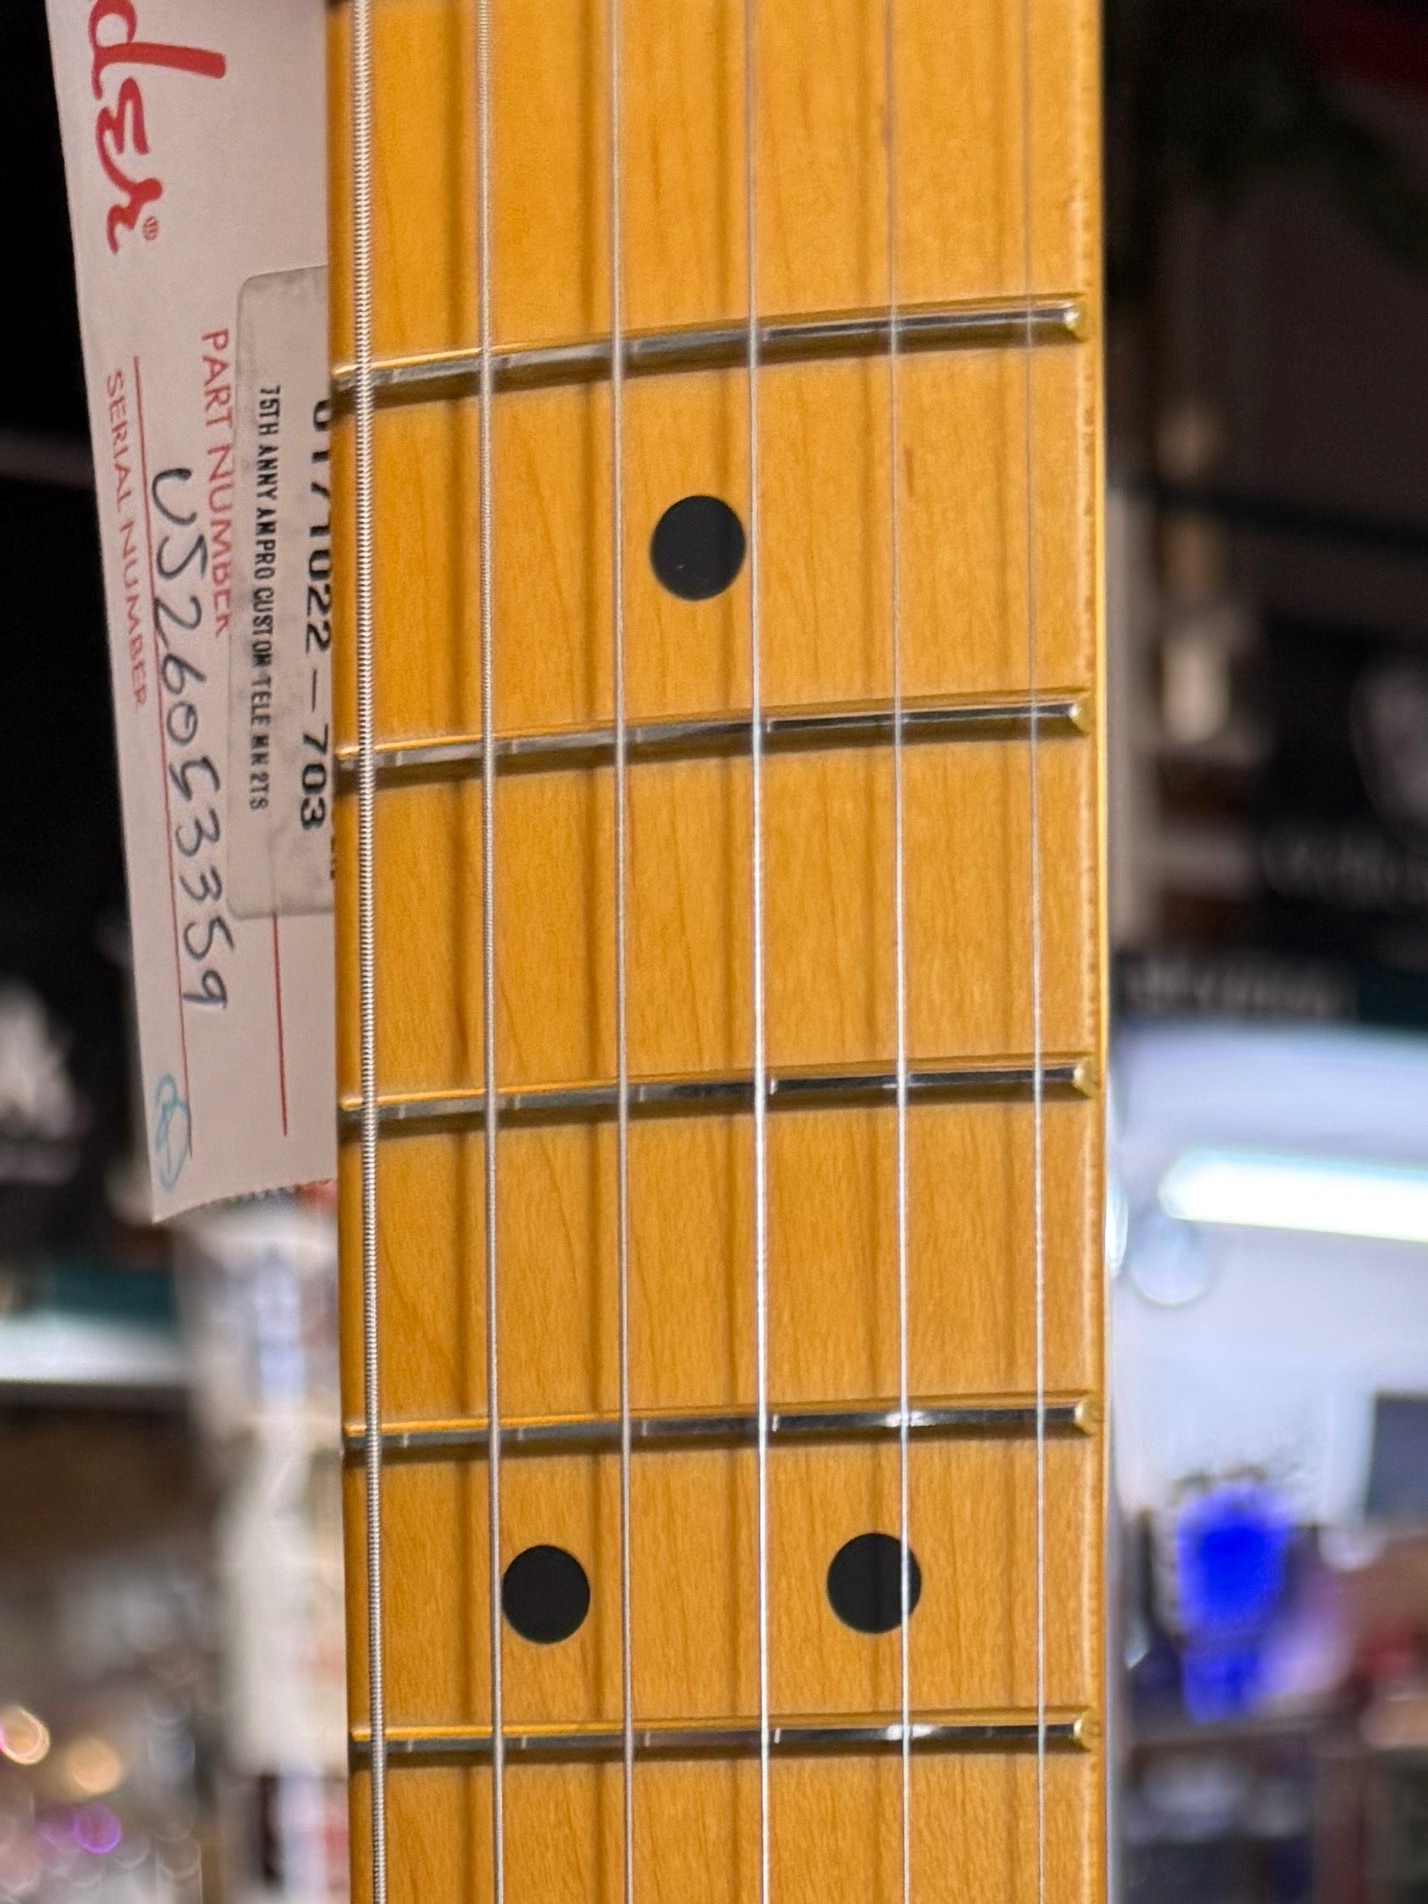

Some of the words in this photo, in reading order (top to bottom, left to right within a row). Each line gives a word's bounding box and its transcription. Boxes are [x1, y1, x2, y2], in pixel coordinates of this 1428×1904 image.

[200, 329, 232, 429] PART
[256, 385, 280, 436] 75TH
[105, 370, 135, 506] SERIAL
[117, 520, 147, 712] NUMBER
[250, 677, 272, 726] TELE
